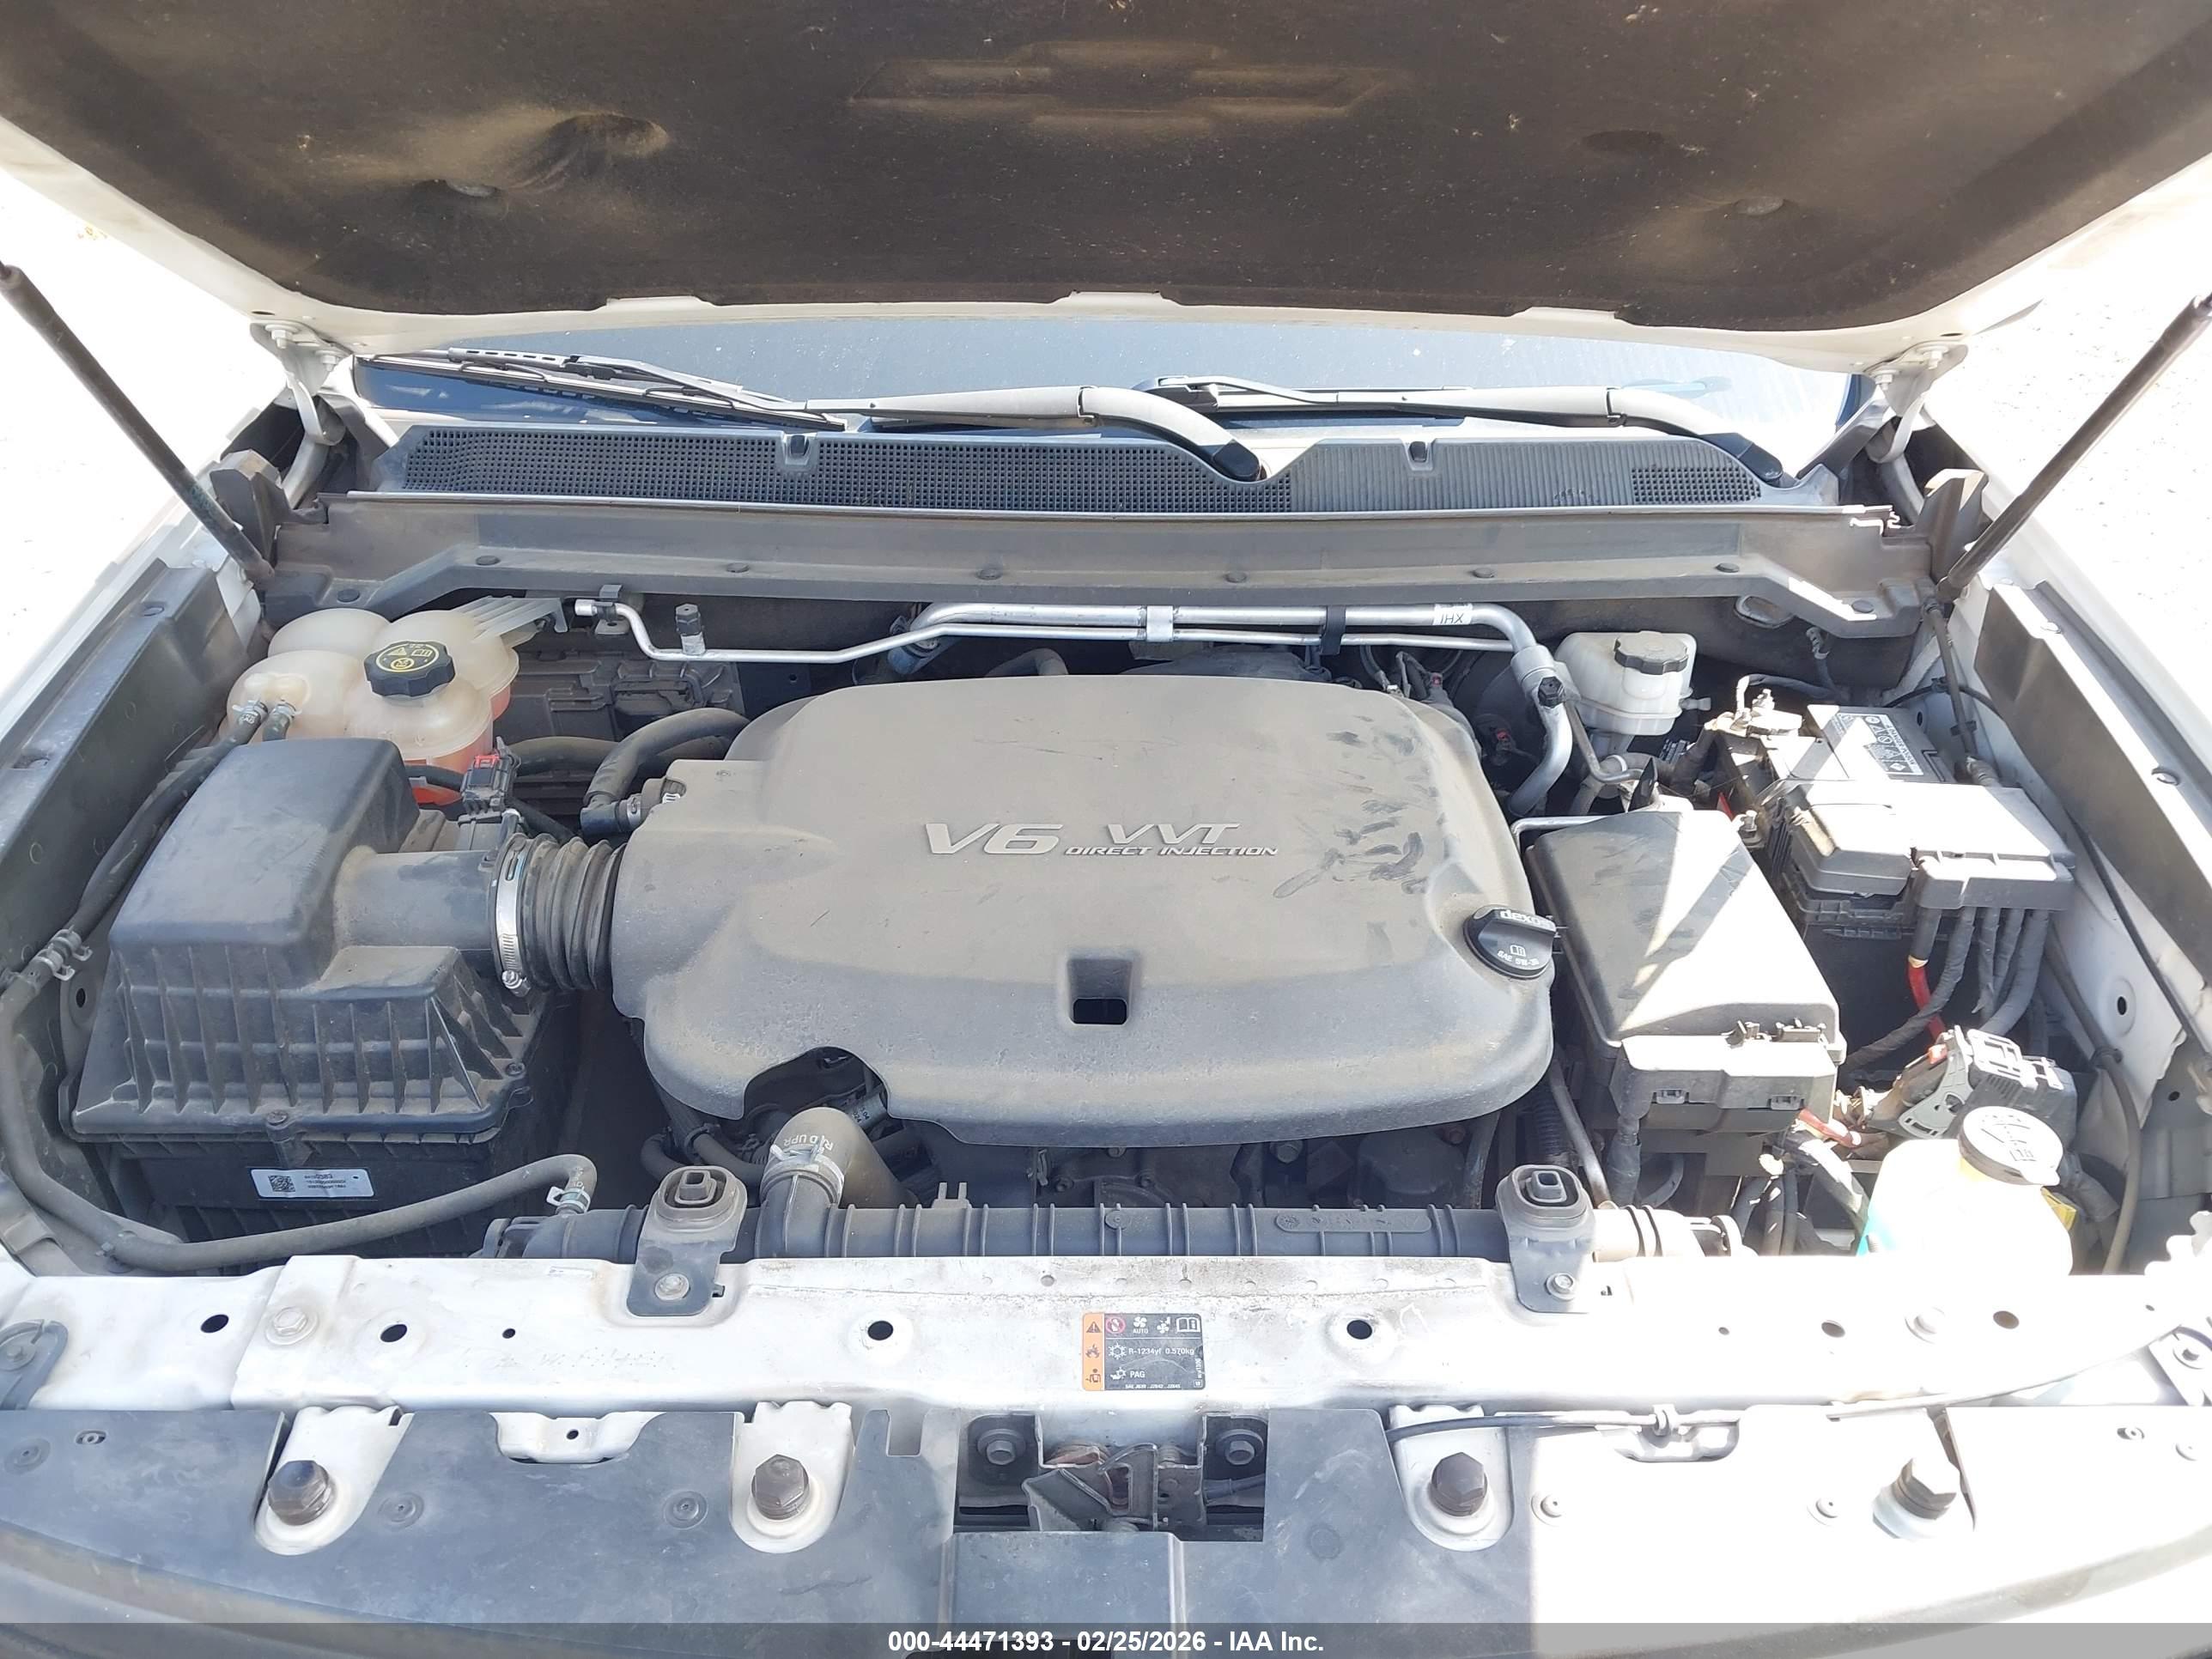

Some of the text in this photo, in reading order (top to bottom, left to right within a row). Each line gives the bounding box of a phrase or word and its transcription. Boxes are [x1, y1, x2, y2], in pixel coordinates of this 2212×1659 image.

[1440, 612, 1464, 623] IHX
[924, 823, 1242, 855] V6 VVT
[1064, 846, 1279, 856] DIRECT INJECTION
[1128, 1347, 1162, 1356] R-1234yf
